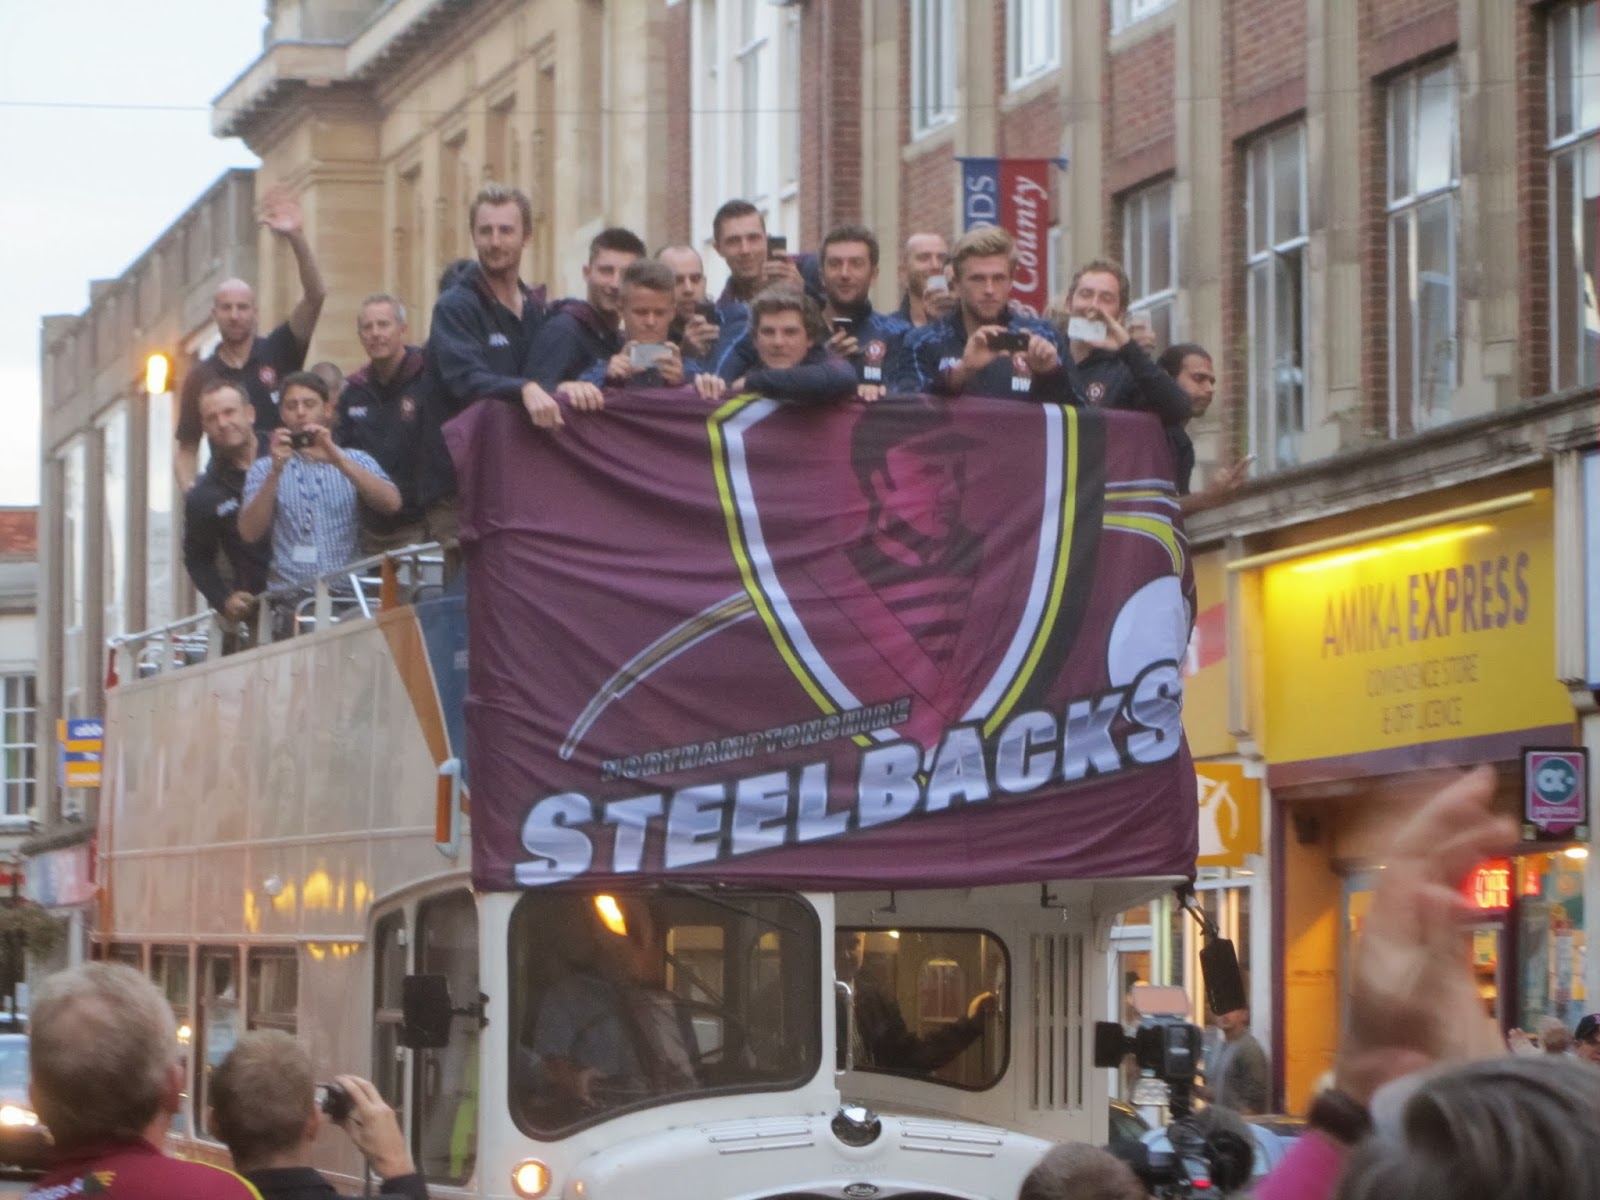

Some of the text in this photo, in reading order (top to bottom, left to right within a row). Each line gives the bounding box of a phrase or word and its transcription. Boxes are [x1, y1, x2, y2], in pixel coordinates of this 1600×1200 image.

[1012, 176, 1047, 292] County
[1321, 551, 1529, 657] AMIKA EXPRESS
[514, 666, 1181, 886] STEELBACKS
[601, 697, 911, 781] NORTHAMPTONSHIRE
